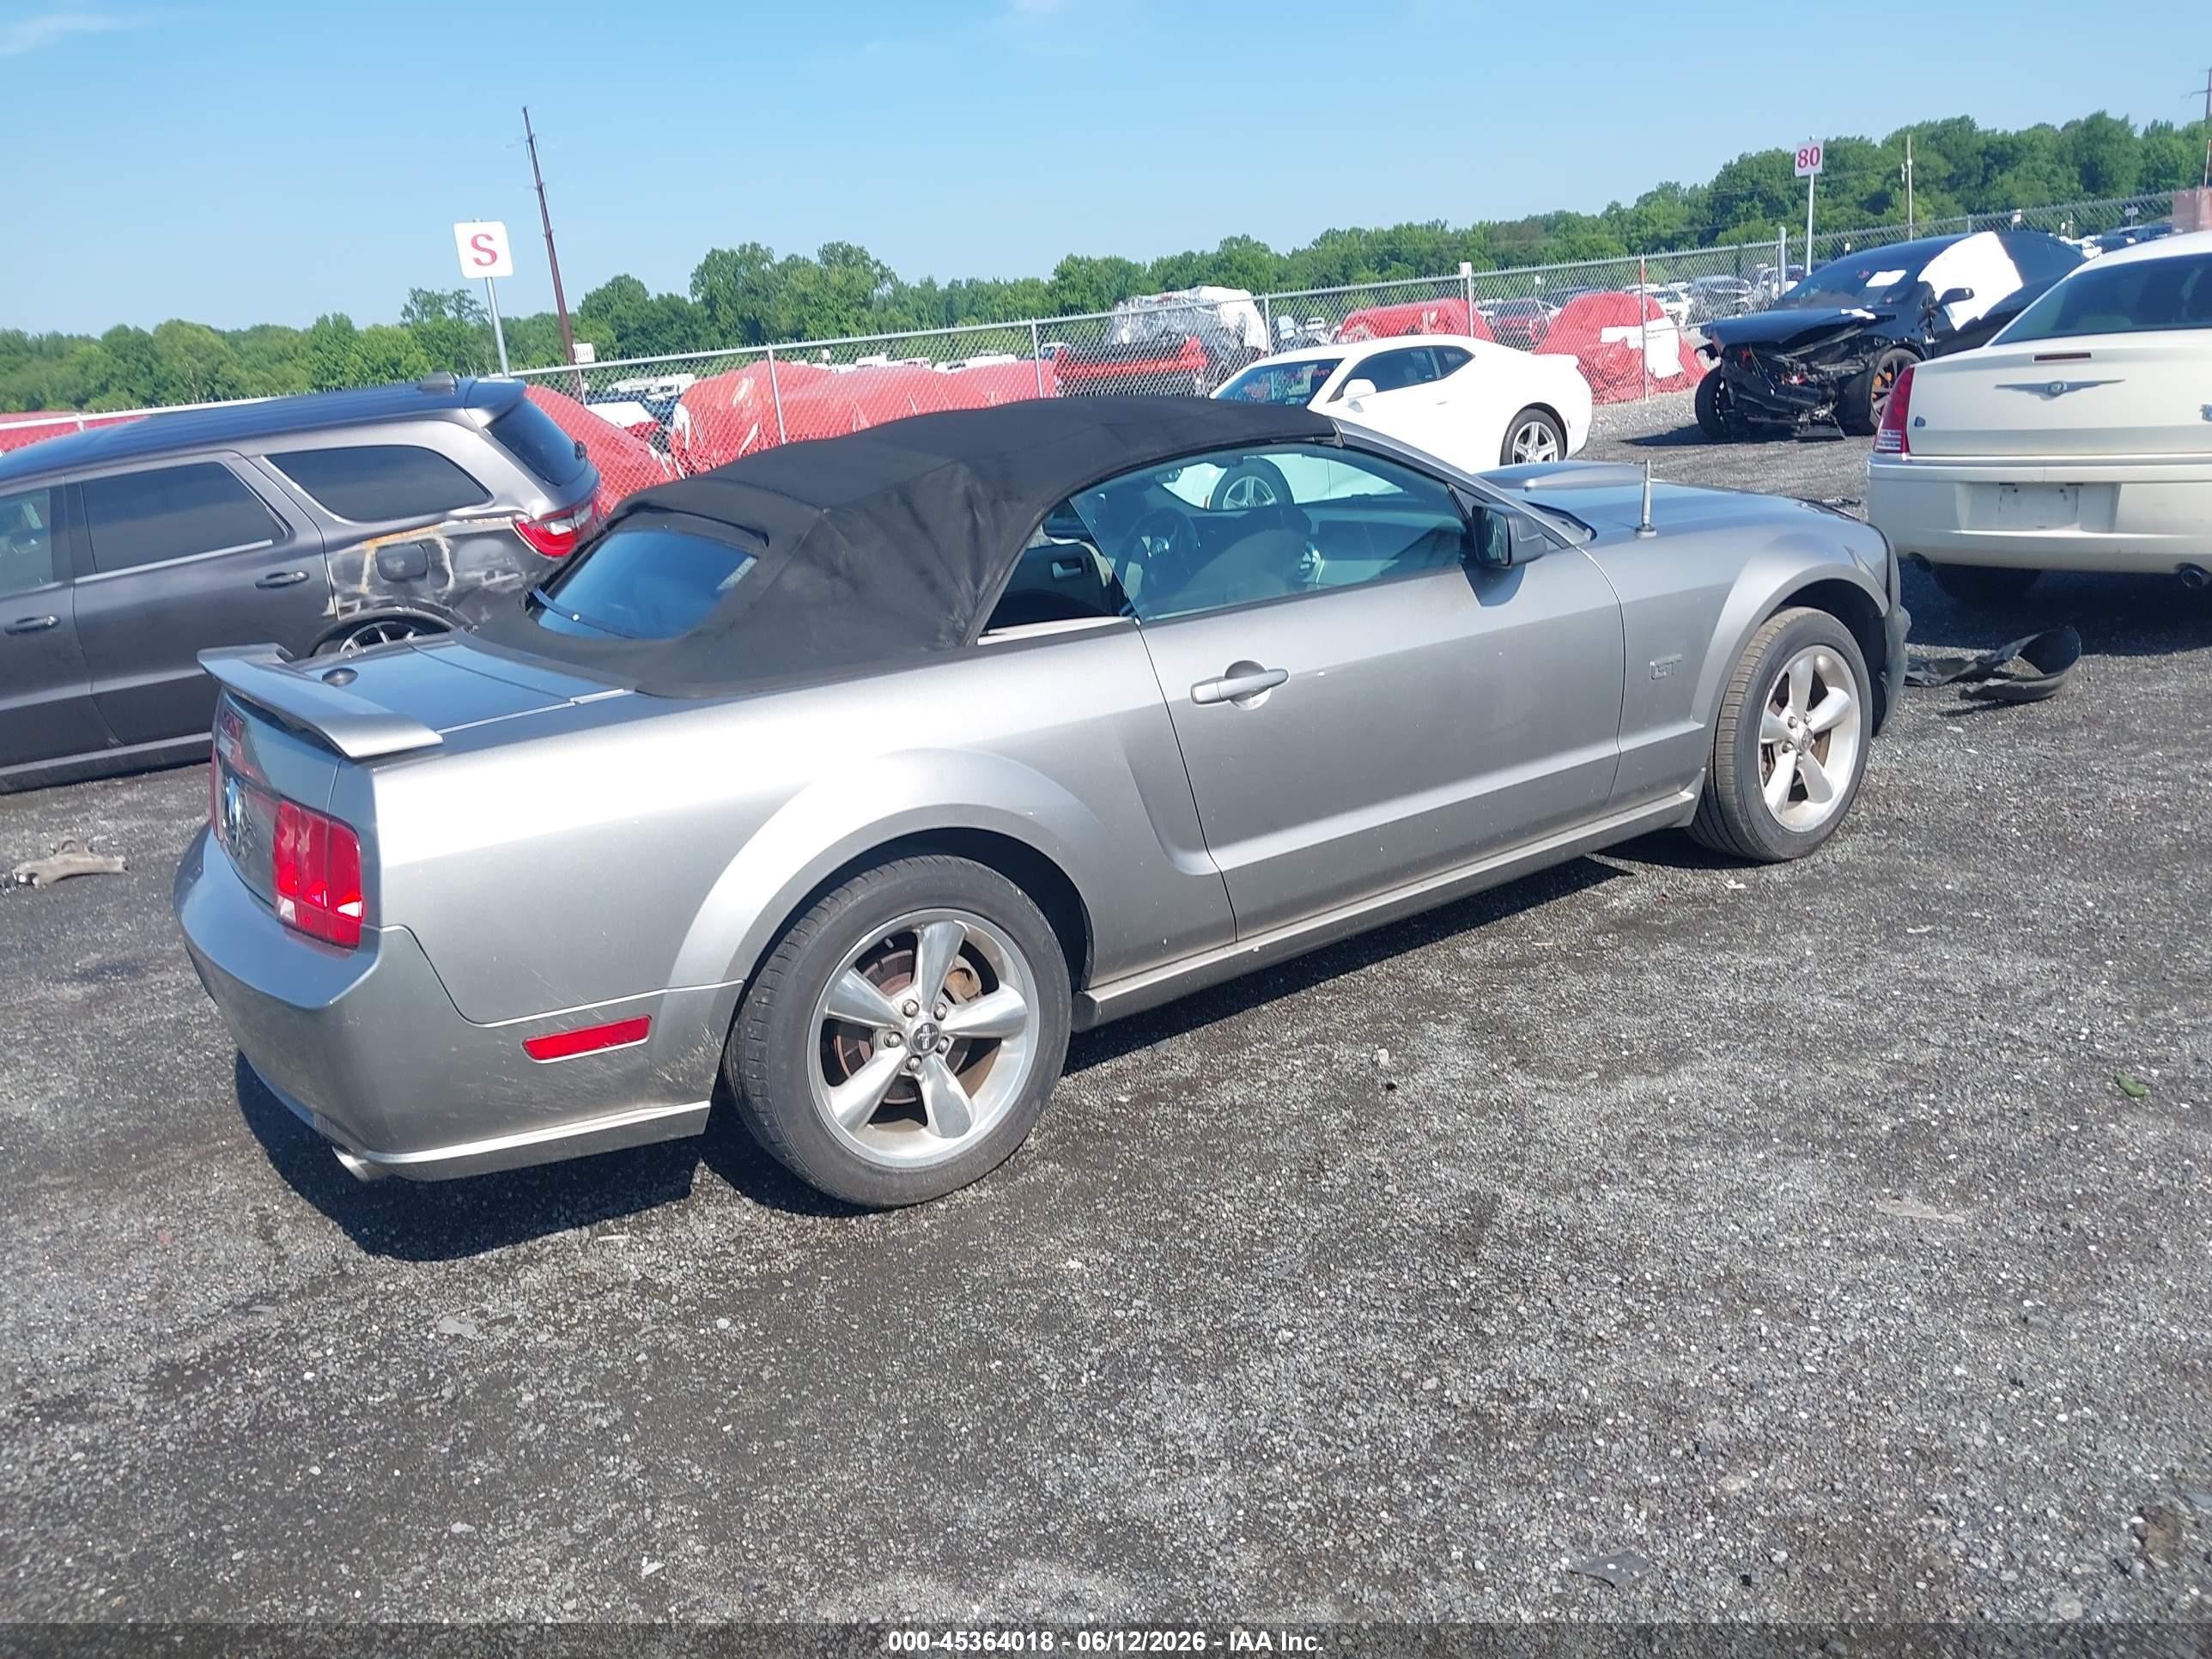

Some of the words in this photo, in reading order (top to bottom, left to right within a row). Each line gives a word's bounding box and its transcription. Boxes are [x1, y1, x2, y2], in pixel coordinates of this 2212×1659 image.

[1797, 147, 1820, 168] 80
[471, 233, 498, 267] S
[1649, 653, 1683, 680] GT
